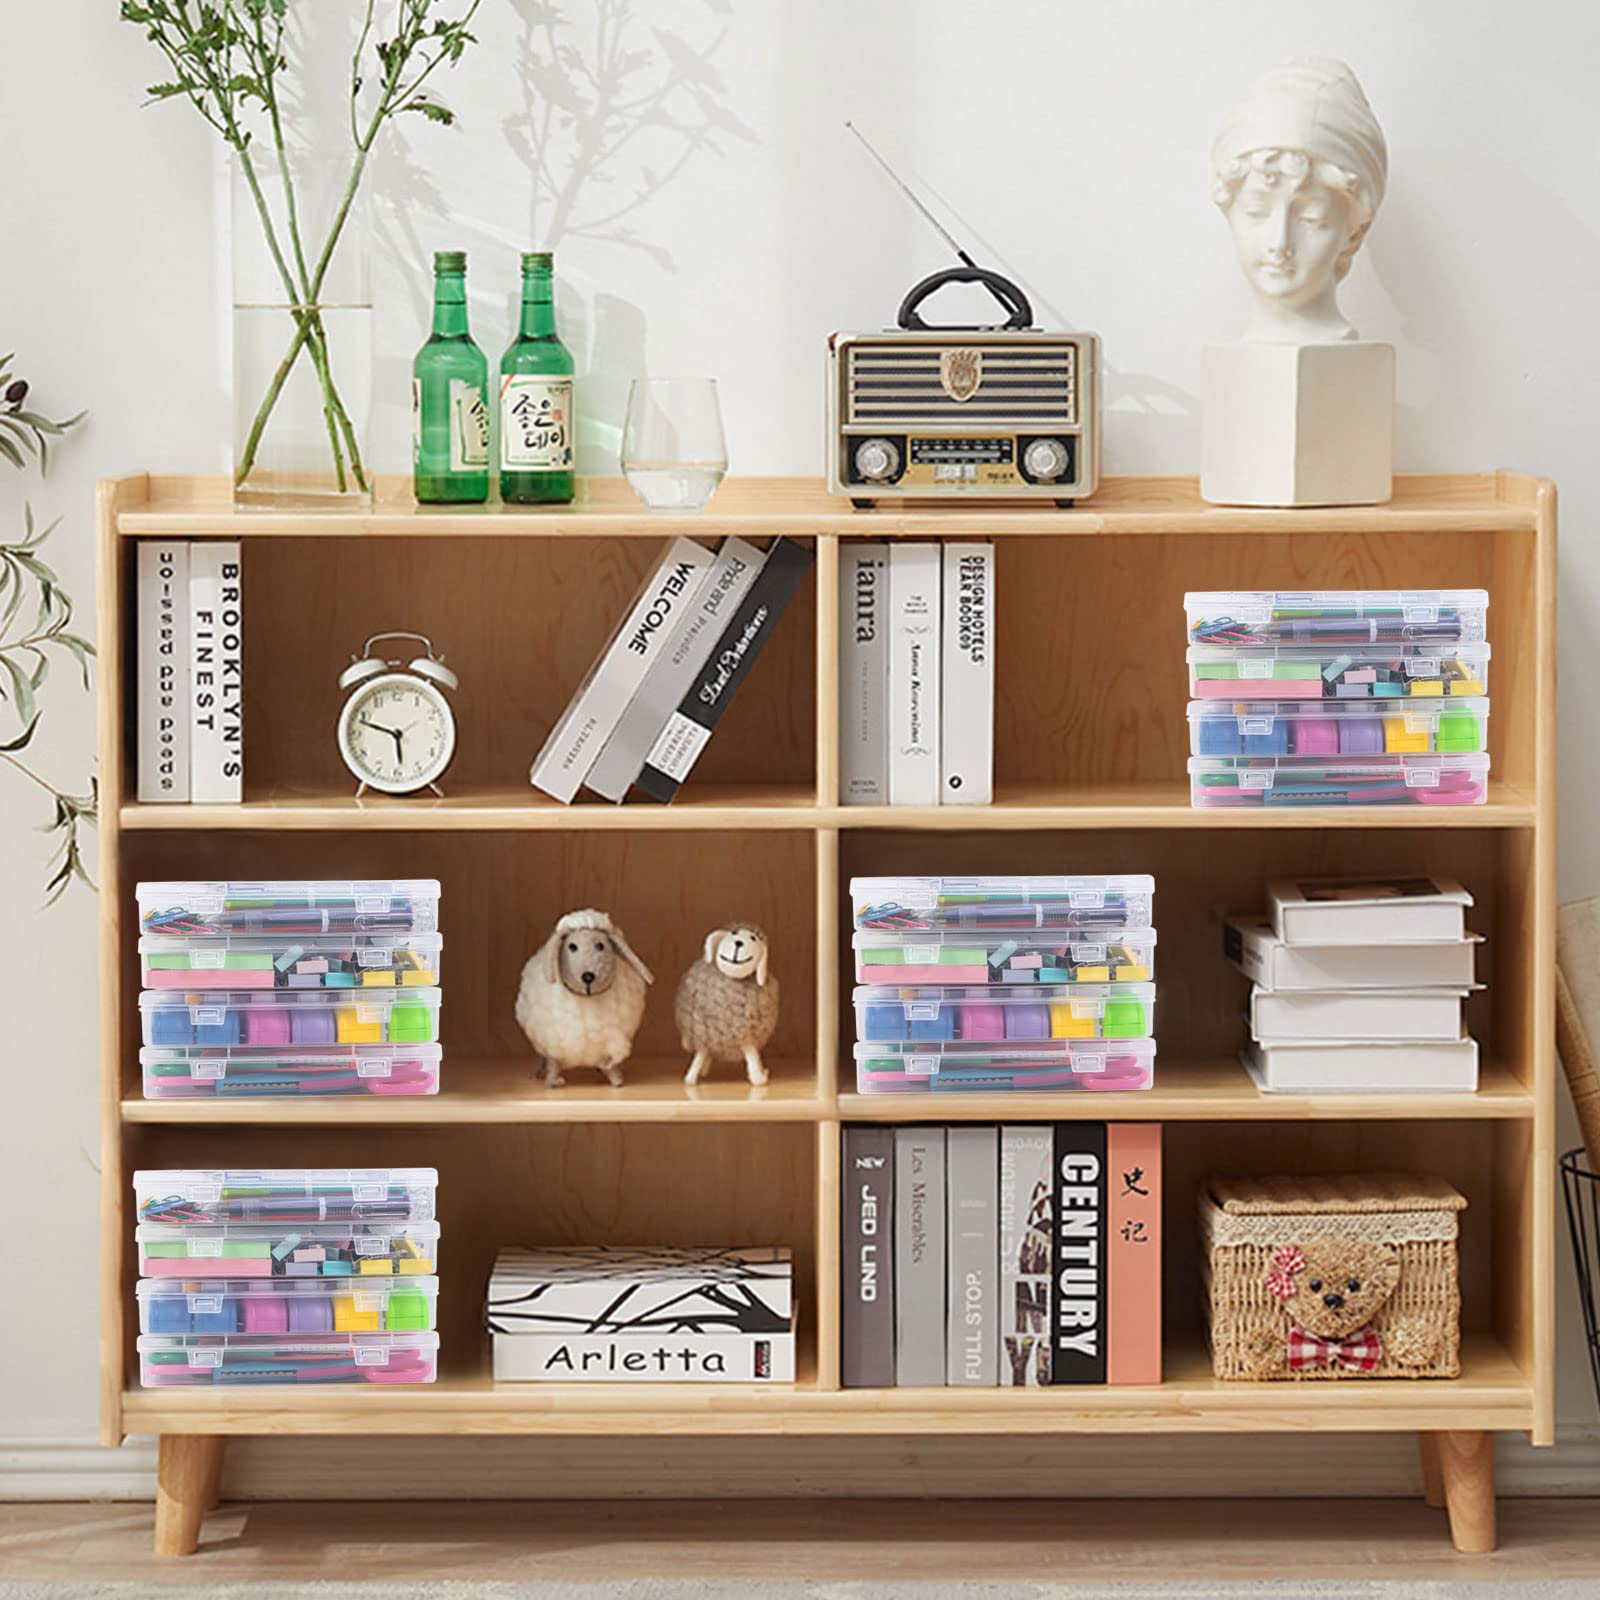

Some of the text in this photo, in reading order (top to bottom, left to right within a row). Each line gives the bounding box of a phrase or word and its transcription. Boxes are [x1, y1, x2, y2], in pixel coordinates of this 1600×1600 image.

[628, 562, 695, 655] WELCOME
[703, 588, 725, 616] and
[718, 556, 747, 591] Pride
[856, 559, 885, 643] ianra
[959, 556, 972, 592] YEAR
[972, 555, 985, 663] DESIGN HOTELS
[159, 665, 173, 707] and
[196, 611, 214, 731] FINEST
[222, 563, 241, 777] BROOKLYN'S
[912, 1147, 927, 1174] Les
[860, 1185, 877, 1302] JED LIND
[1059, 1153, 1100, 1357] CENTURY
[545, 1344, 725, 1372] Arletta
[965, 1269, 982, 1380] FULL STOP.
